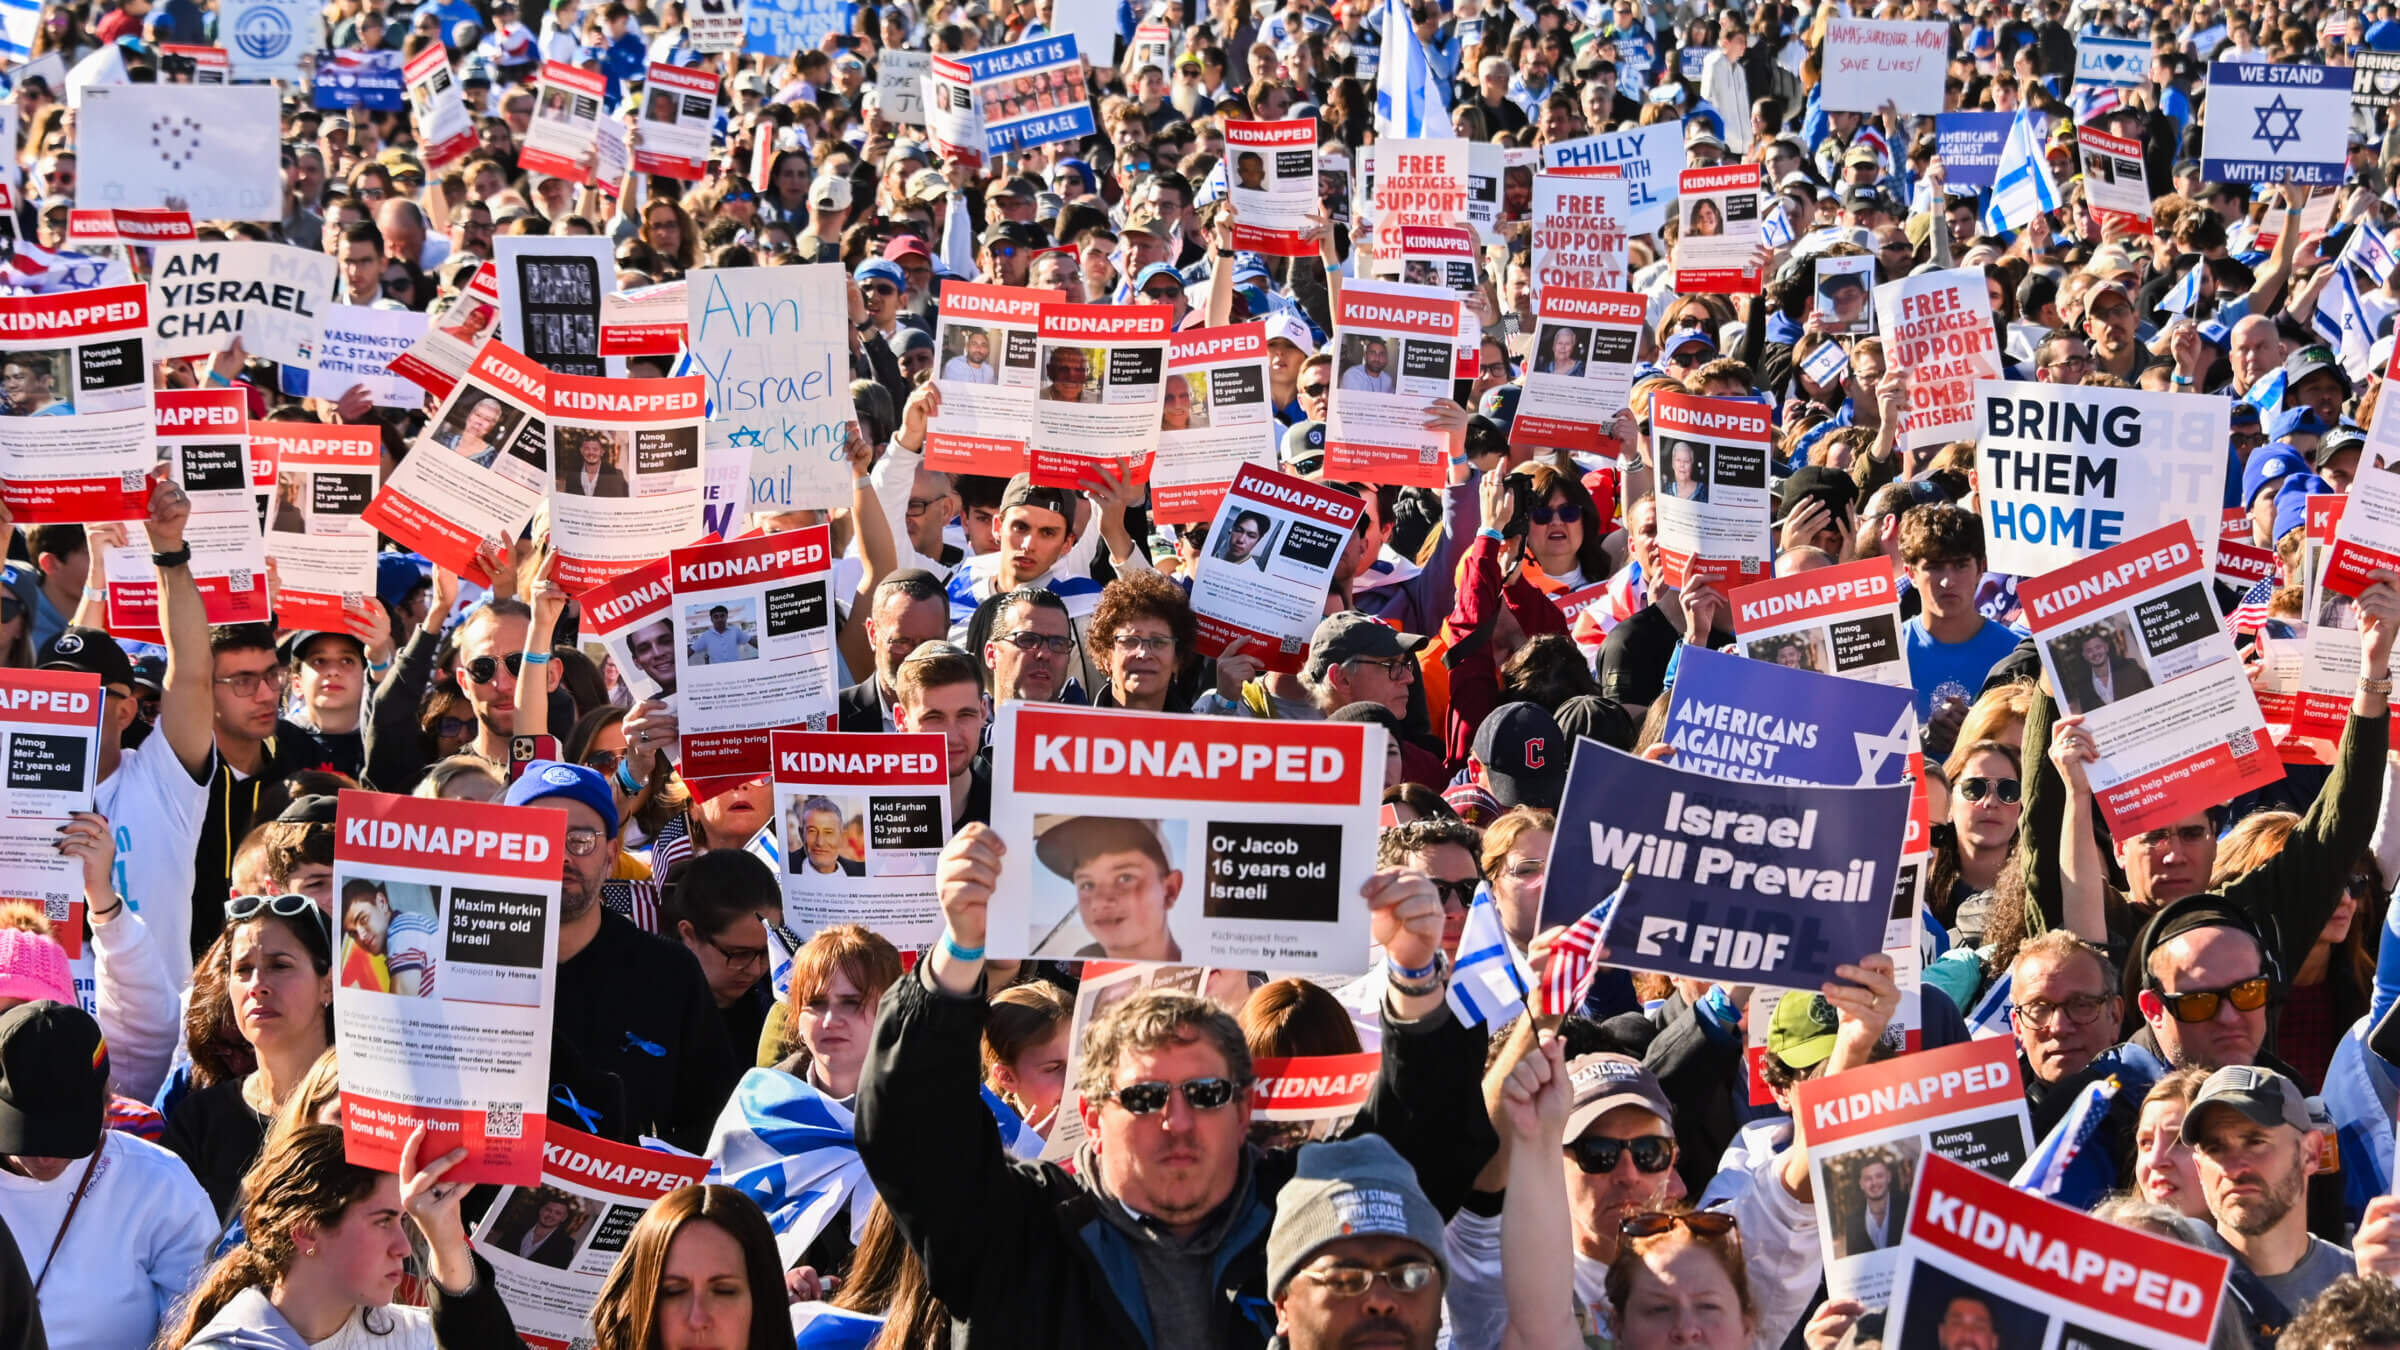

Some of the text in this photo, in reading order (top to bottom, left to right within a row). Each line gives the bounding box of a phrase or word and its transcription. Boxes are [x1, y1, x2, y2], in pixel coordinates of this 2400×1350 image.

[751, 11, 845, 37] JEWISH
[972, 43, 1064, 77] Y HEART IS
[1840, 57, 1869, 72] SAVE
[2357, 53, 2400, 71] BRING
[2240, 66, 2323, 84] WE STAND
[987, 115, 1078, 147] ITH ISRAEL
[1229, 128, 1312, 142] KIDNAPPED
[1939, 131, 1998, 143] AMERICANS
[1556, 134, 1646, 167] PHILLY
[1939, 143, 1984, 154] AGAINST
[1398, 155, 1446, 174] FREE
[2224, 163, 2262, 180] WITH
[1387, 176, 1455, 189] HOSTAGES
[1683, 172, 1757, 190] KIDNAPPED
[1376, 192, 1467, 211] SUPPORT
[1557, 195, 1605, 214] FREE
[118, 216, 191, 236] KIDNAPPED
[1398, 213, 1444, 226] ISRAEL
[1546, 215, 1616, 231] HOSTAGES
[1406, 236, 1469, 251] KIDNAPPED
[1534, 230, 1627, 252] SUPPORT
[162, 251, 220, 278] AM
[1556, 252, 1603, 267] ISRAEL
[1540, 269, 1620, 289] COMBAT
[160, 280, 314, 318] YISRAEL
[699, 273, 799, 342] Am
[947, 294, 1040, 317] KIDNAPP
[1546, 297, 1641, 317] KIDNAPPED
[1902, 287, 1961, 320] FREE
[0, 301, 140, 330] KIDNAPPED
[156, 309, 244, 338] CHAI
[1044, 316, 1164, 333] KIDNAPPED
[1345, 304, 1453, 328] KIDNAPPED
[1895, 310, 1978, 342] HOSTAGES
[82, 347, 122, 358] Pongsak
[1170, 335, 1260, 360] DNAPPED
[1407, 346, 1426, 355] Segev
[1886, 327, 1993, 370] SUPPORT
[481, 356, 545, 401] KIDNA
[1915, 358, 1974, 383] ISRAEL
[695, 349, 832, 414] Yisrael
[554, 390, 698, 412] KIDNAPPED
[156, 406, 239, 426] NAPPED
[1659, 404, 1766, 433] KIDNAPPED
[1986, 396, 2142, 448] BRING
[640, 433, 666, 442] Almog
[185, 451, 196, 459] Tu
[639, 459, 664, 468] Israeli
[640, 451, 649, 460] 21
[651, 451, 673, 460] years
[1718, 454, 1761, 464] Hannah Katzir
[1987, 449, 2118, 500] THEM
[1239, 475, 1355, 521] KIDNAPPED
[1991, 501, 2125, 551] HOME
[680, 544, 823, 583] KIDNAPPED
[2032, 542, 2191, 619] KIDNAPPED
[592, 575, 671, 624] KIDNAP
[769, 593, 795, 603] Bancha
[1741, 575, 1888, 622] KIDNAPPED
[2140, 601, 2169, 617] Almog
[2142, 607, 2181, 627] Meir Jan
[771, 619, 786, 627] Thai
[1834, 625, 1861, 635] Almog
[2146, 612, 2200, 638] 21 years old
[1836, 633, 1870, 645] Meir Jan
[1837, 640, 1886, 655] 21 years old
[2150, 633, 2179, 649] Israeli
[1838, 654, 1864, 665] Israeli
[0, 689, 90, 714] APPED
[1674, 697, 1819, 750] AMERICANS
[15, 737, 46, 749] Almog
[691, 734, 768, 748] Please help bring
[1670, 725, 1781, 771] AGAINST
[14, 749, 55, 760] Meir Jan
[691, 746, 743, 757] home alive.
[1032, 733, 1345, 784] KIDNAPPED
[1523, 737, 1546, 770] C
[12, 760, 71, 772] 21 years old
[780, 752, 938, 773] KIDNAPPED
[12, 772, 41, 782] Israeli
[2109, 758, 2216, 804] Please help bring them
[873, 803, 927, 812] Kaid Farhan
[2114, 792, 2168, 817] home alive.
[874, 814, 907, 823] Al-Qadi
[1664, 791, 1818, 851] Israel
[345, 817, 549, 862] KIDNAPPED
[874, 824, 928, 835] 53 years old
[874, 836, 902, 845] Israeli
[1212, 835, 1299, 856] Or Jacob
[1211, 859, 1326, 880] 16 years old
[1588, 820, 1877, 903] Will Prevail
[1210, 882, 1268, 901] Israeli
[454, 898, 541, 917] Maxim Herkin
[453, 915, 531, 933] 35 years old
[452, 932, 491, 946] Israeli
[1210, 930, 1298, 945] Kidnapped from
[1689, 923, 1790, 973] FIDF
[421, 1021, 449, 1031] innocent
[451, 1023, 480, 1033] civilians
[481, 1027, 499, 1035] were
[500, 1028, 534, 1037] abducted
[1813, 1061, 2011, 1129] KIDNAPPED
[351, 1119, 397, 1141] home alive.
[1936, 1131, 1974, 1147] Almog
[543, 1141, 694, 1192] KIDNAPPED
[1925, 1188, 2203, 1319] KIDNAPPED
